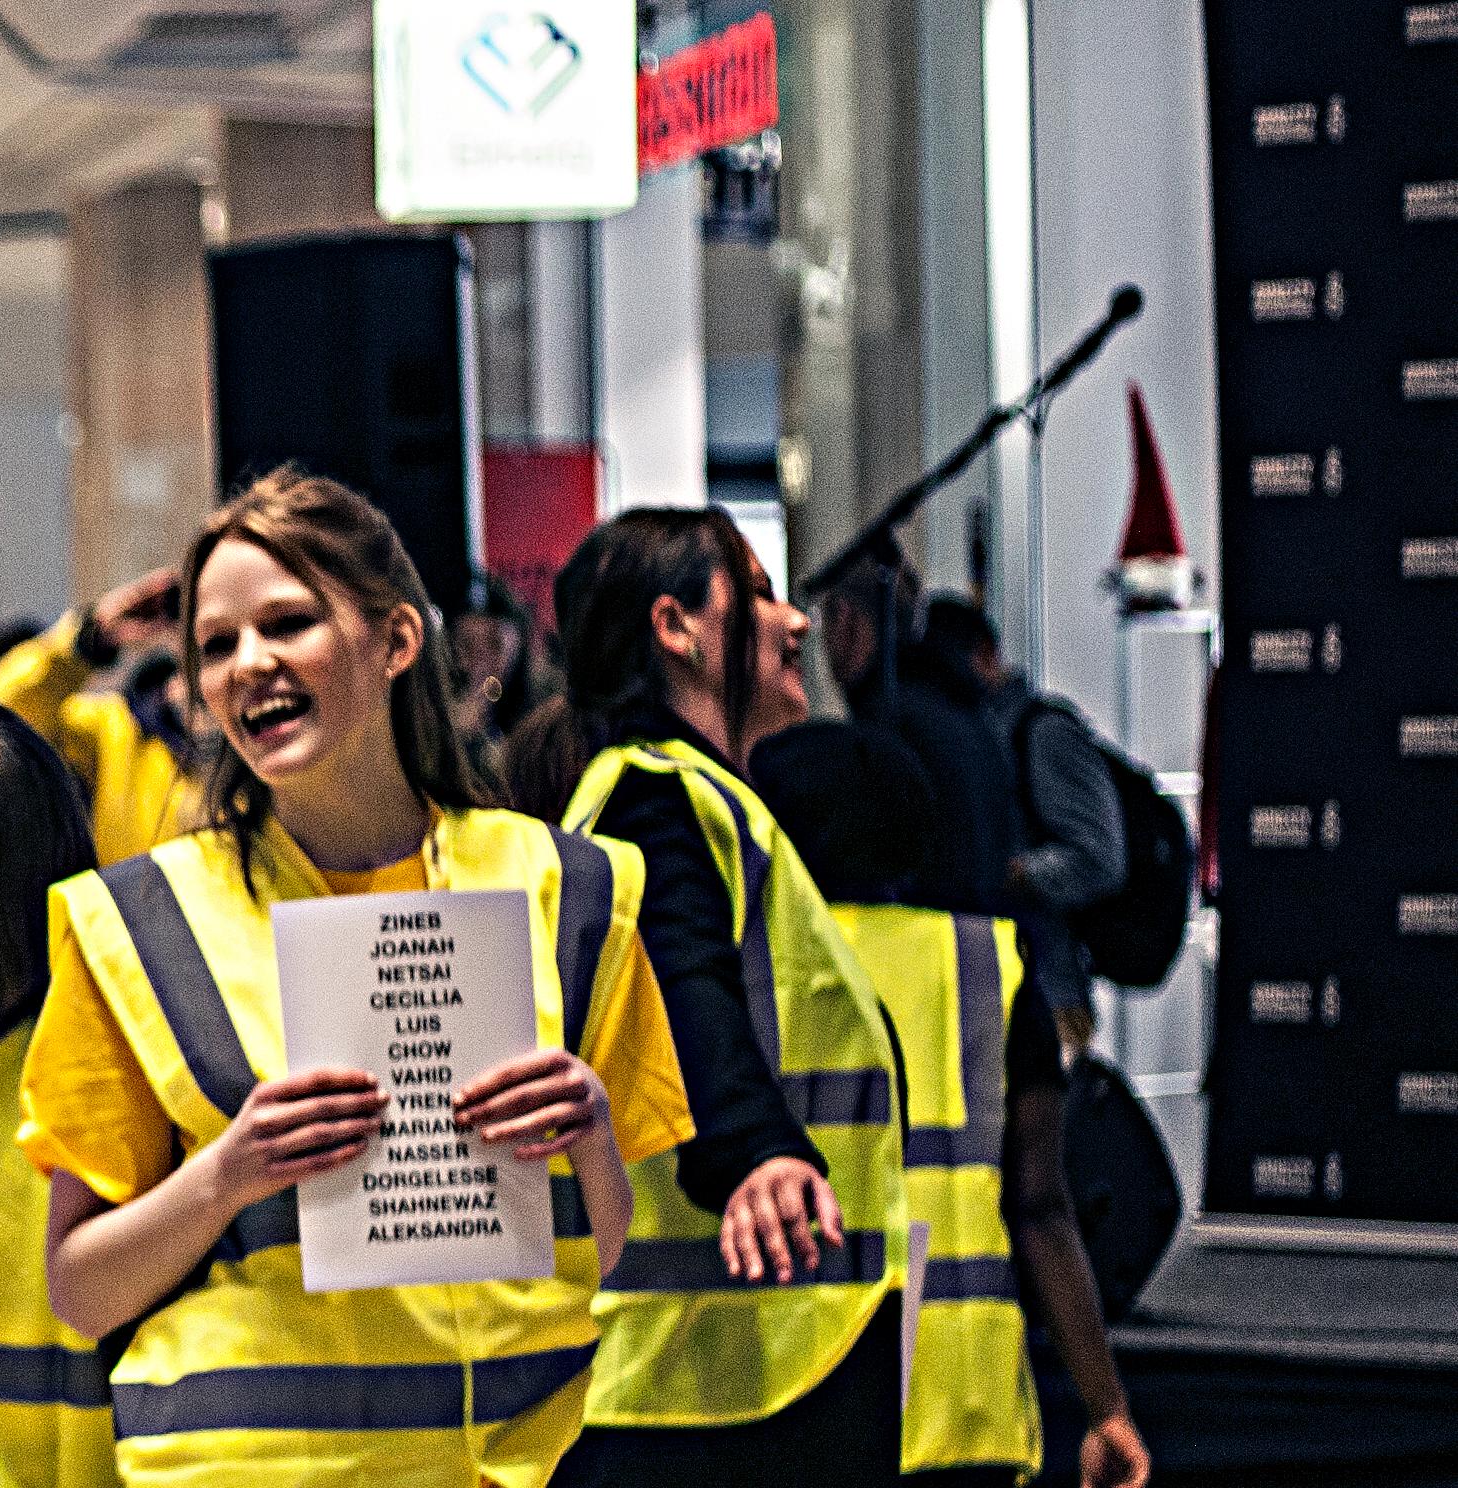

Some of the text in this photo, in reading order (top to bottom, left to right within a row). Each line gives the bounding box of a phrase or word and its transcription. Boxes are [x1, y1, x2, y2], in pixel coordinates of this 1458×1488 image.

[379, 910, 442, 933] ZINEB
[369, 936, 455, 960] JOANAH
[377, 962, 452, 984] NETSAI
[369, 986, 463, 1011] CECILLIA
[394, 1014, 442, 1036] LUIS
[387, 1040, 452, 1062] CHOW
[389, 1065, 452, 1087] VAHID
[396, 1091, 452, 1111] YREN
[387, 1140, 471, 1163] NASSER
[363, 1164, 498, 1192] DORGELESSE
[368, 1189, 498, 1217] SHAHNEWAZ
[367, 1216, 504, 1243] ALEKSANDRA
